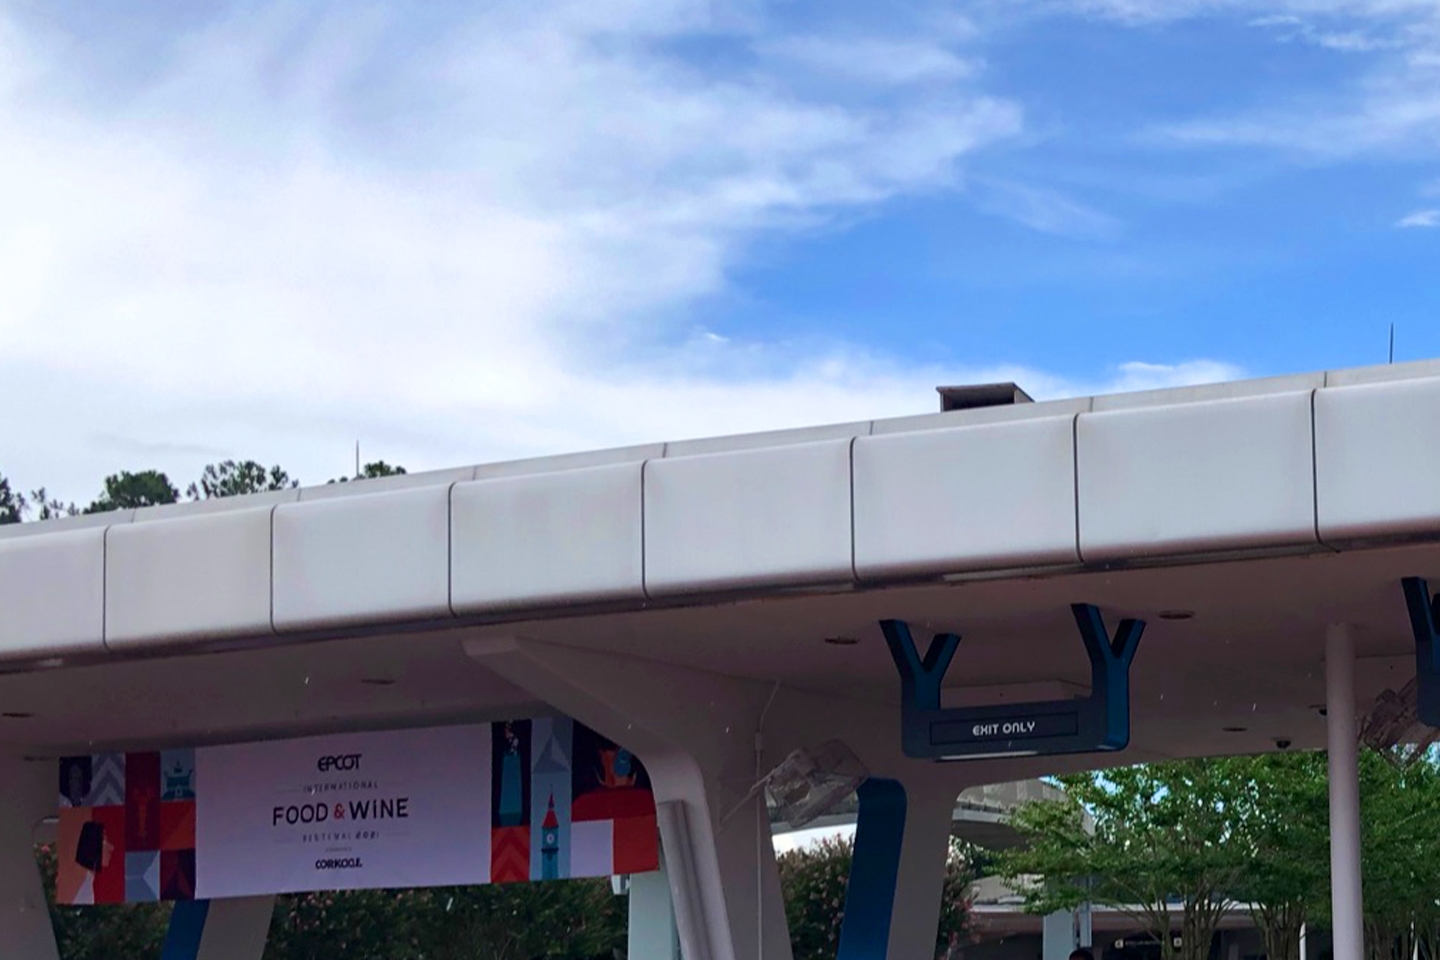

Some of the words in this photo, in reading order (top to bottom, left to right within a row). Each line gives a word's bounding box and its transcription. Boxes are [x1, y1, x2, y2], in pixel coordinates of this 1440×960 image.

[972, 723, 1000, 736] EXIT
[1003, 721, 1036, 733] ONLY
[317, 753, 362, 772] EPCOT
[273, 802, 328, 826] FOOD
[334, 803, 345, 819] &
[349, 797, 409, 820] WINE
